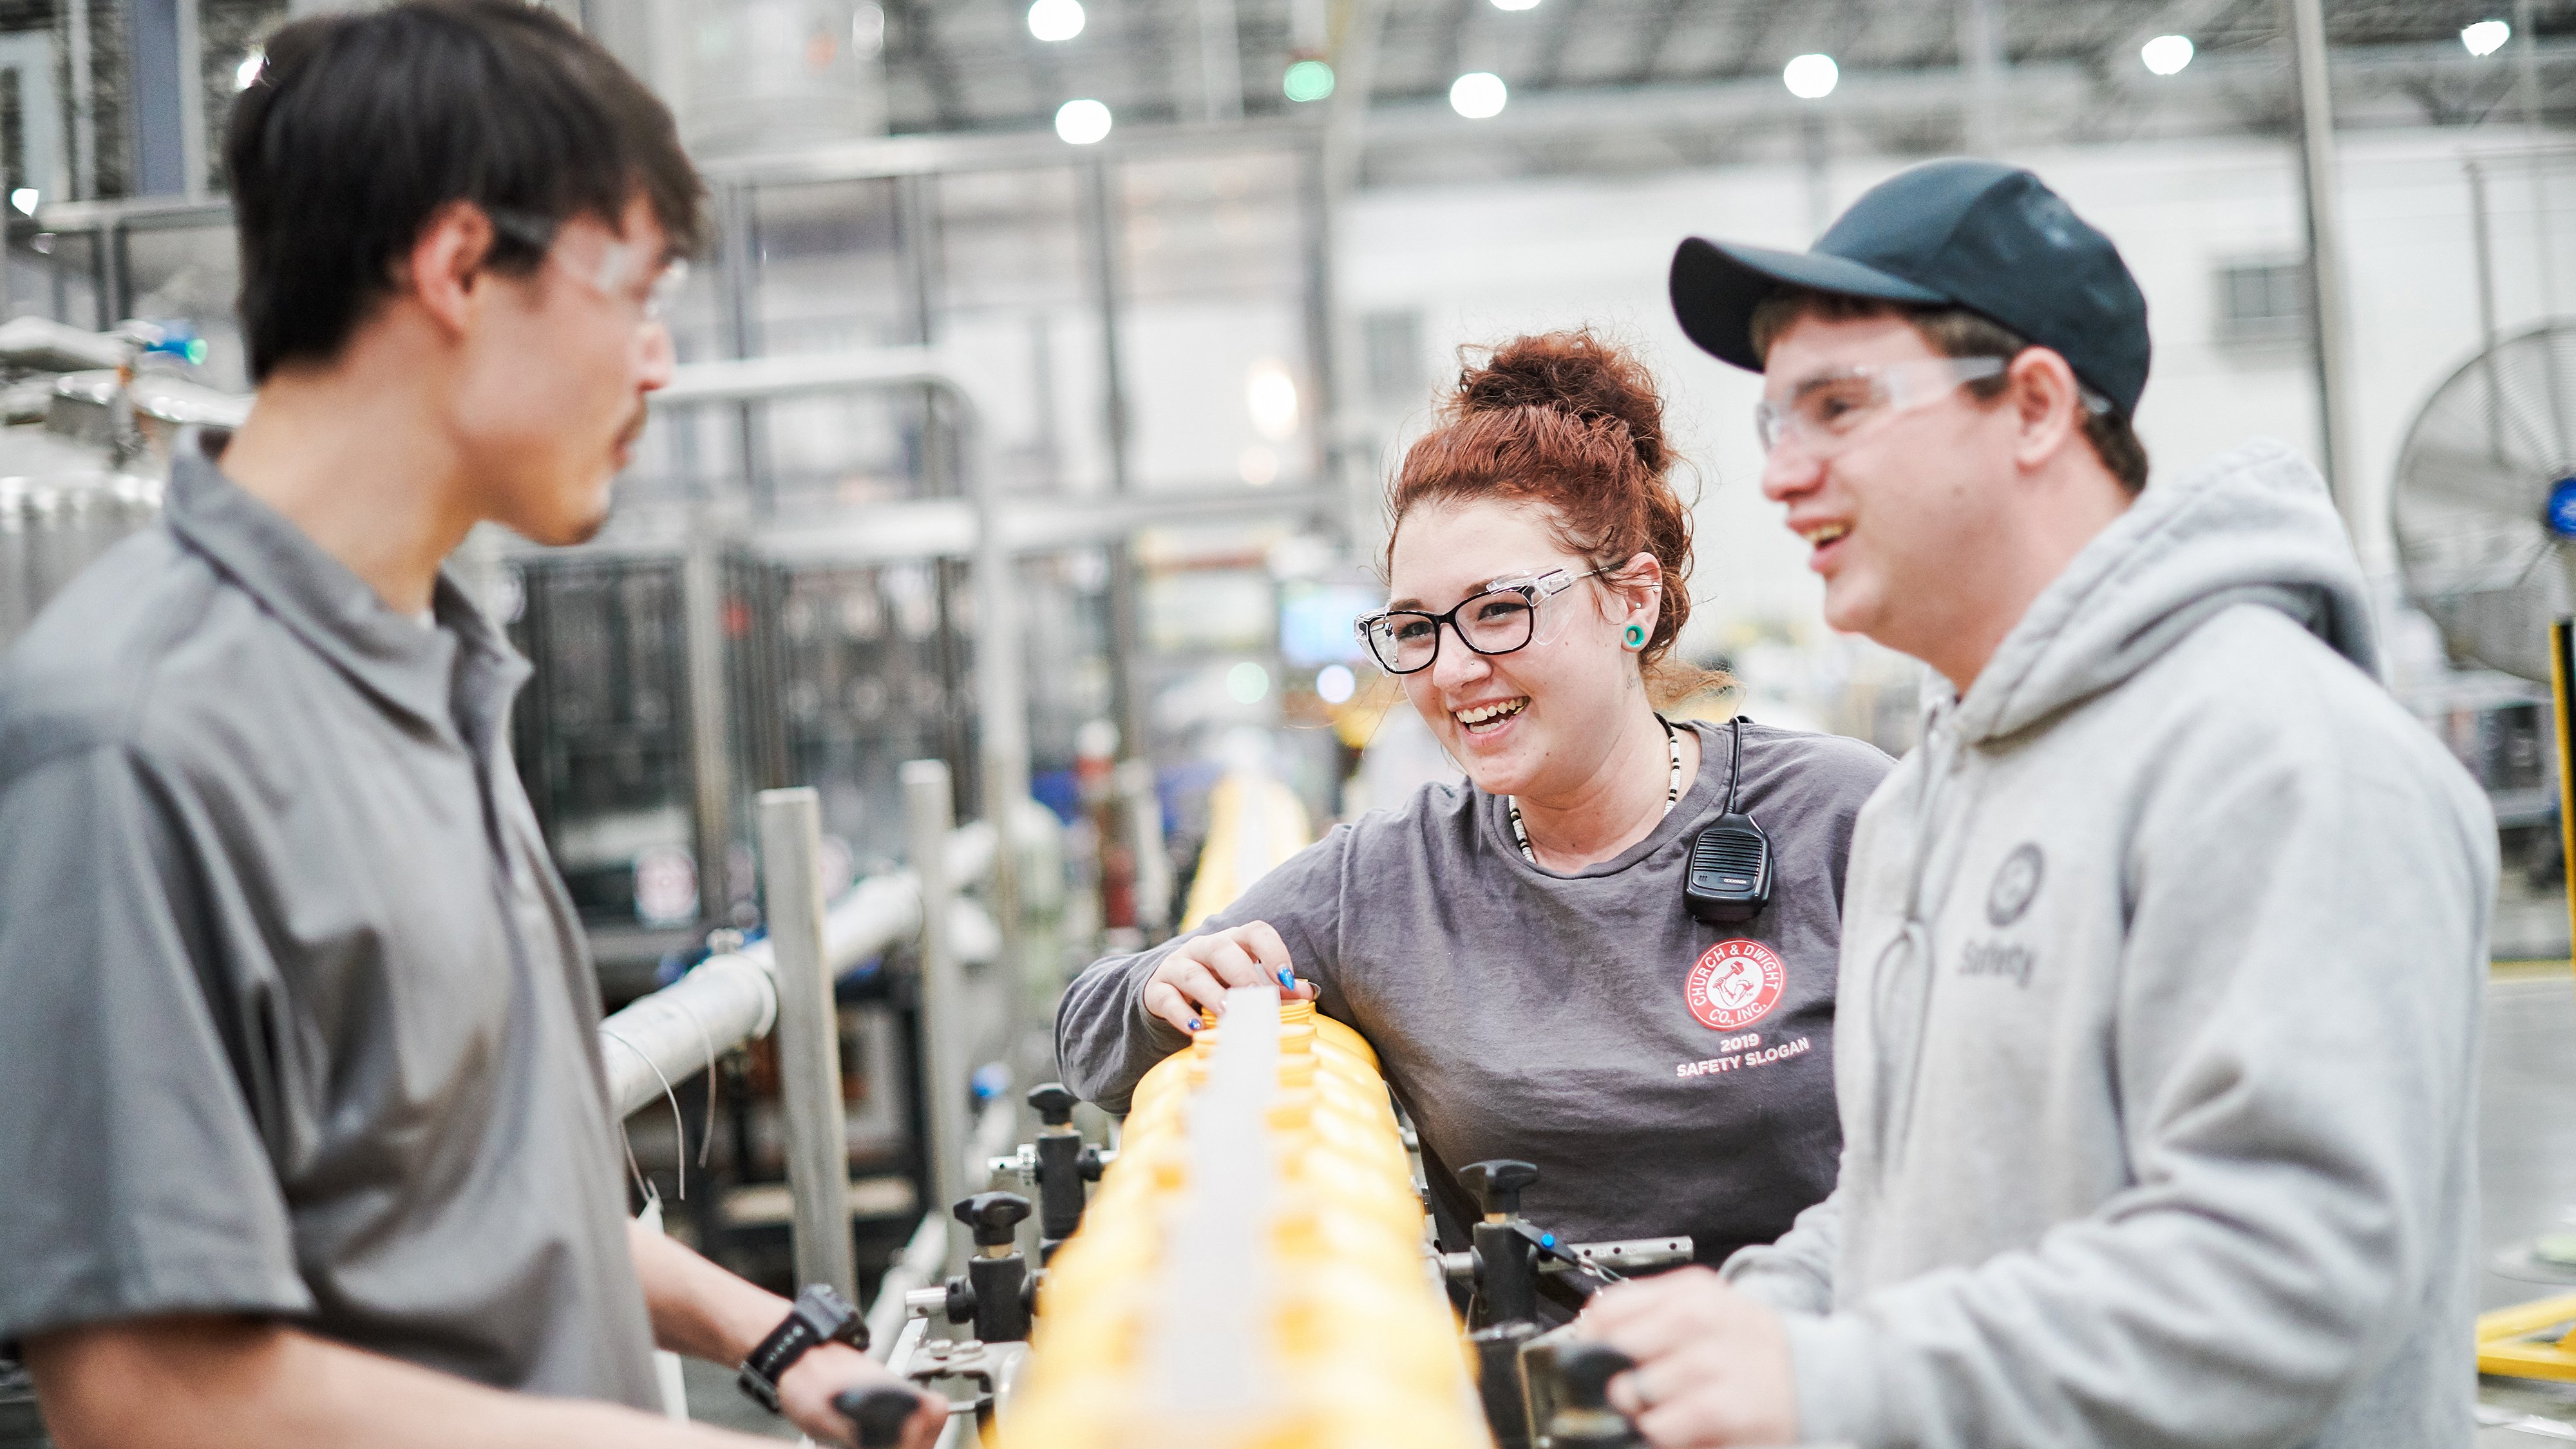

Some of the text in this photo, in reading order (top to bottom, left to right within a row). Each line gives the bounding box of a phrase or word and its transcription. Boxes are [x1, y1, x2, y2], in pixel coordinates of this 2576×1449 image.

[1691, 944, 1779, 1006] CHURCH & DWIGHT
[1709, 1002, 1767, 1024] CO., INC.
[1676, 1037, 1810, 1077] SAFETY SLOGAN
[1720, 1034, 1759, 1052] 2019
